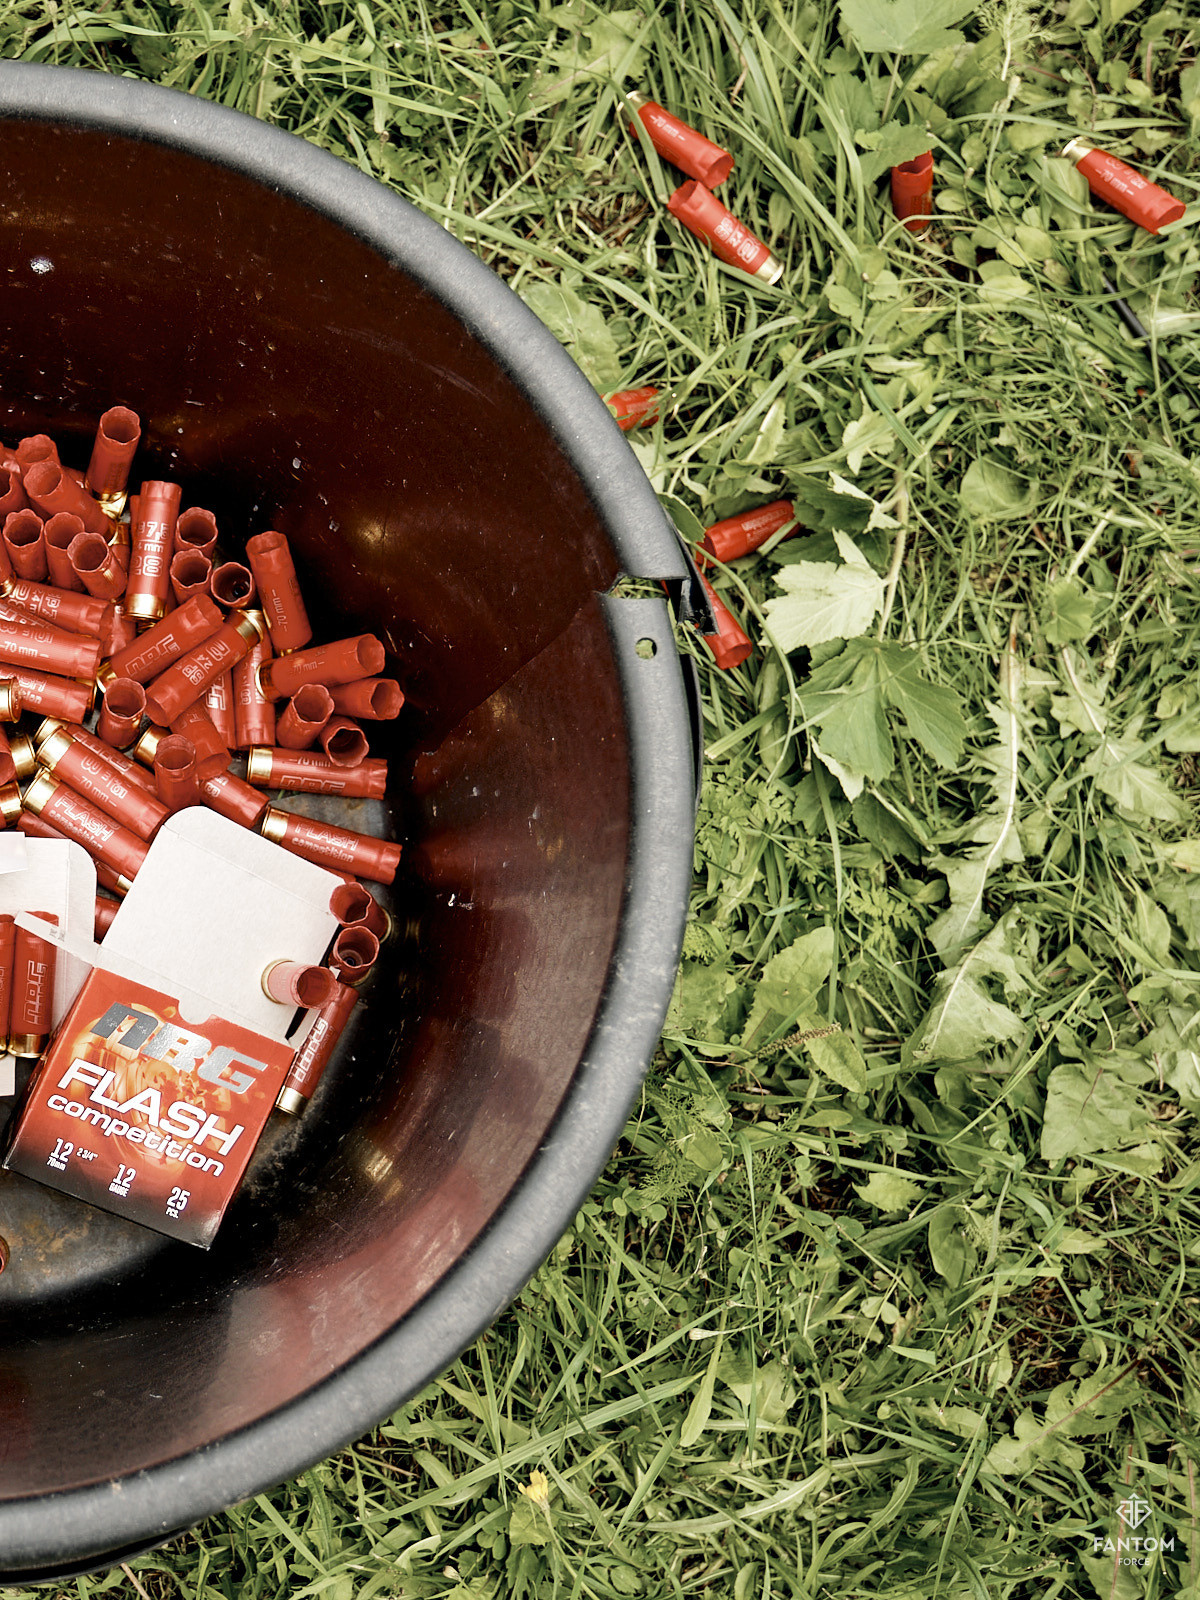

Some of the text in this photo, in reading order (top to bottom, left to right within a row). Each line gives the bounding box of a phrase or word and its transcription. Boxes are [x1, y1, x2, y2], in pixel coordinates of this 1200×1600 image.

[47, 1093, 226, 1178] competition
[56, 1057, 246, 1157] FLASH
[49, 1137, 74, 1163] 12
[112, 1163, 137, 1189] 12
[166, 1186, 191, 1212] 25
[108, 1182, 130, 1198] GAUGE
